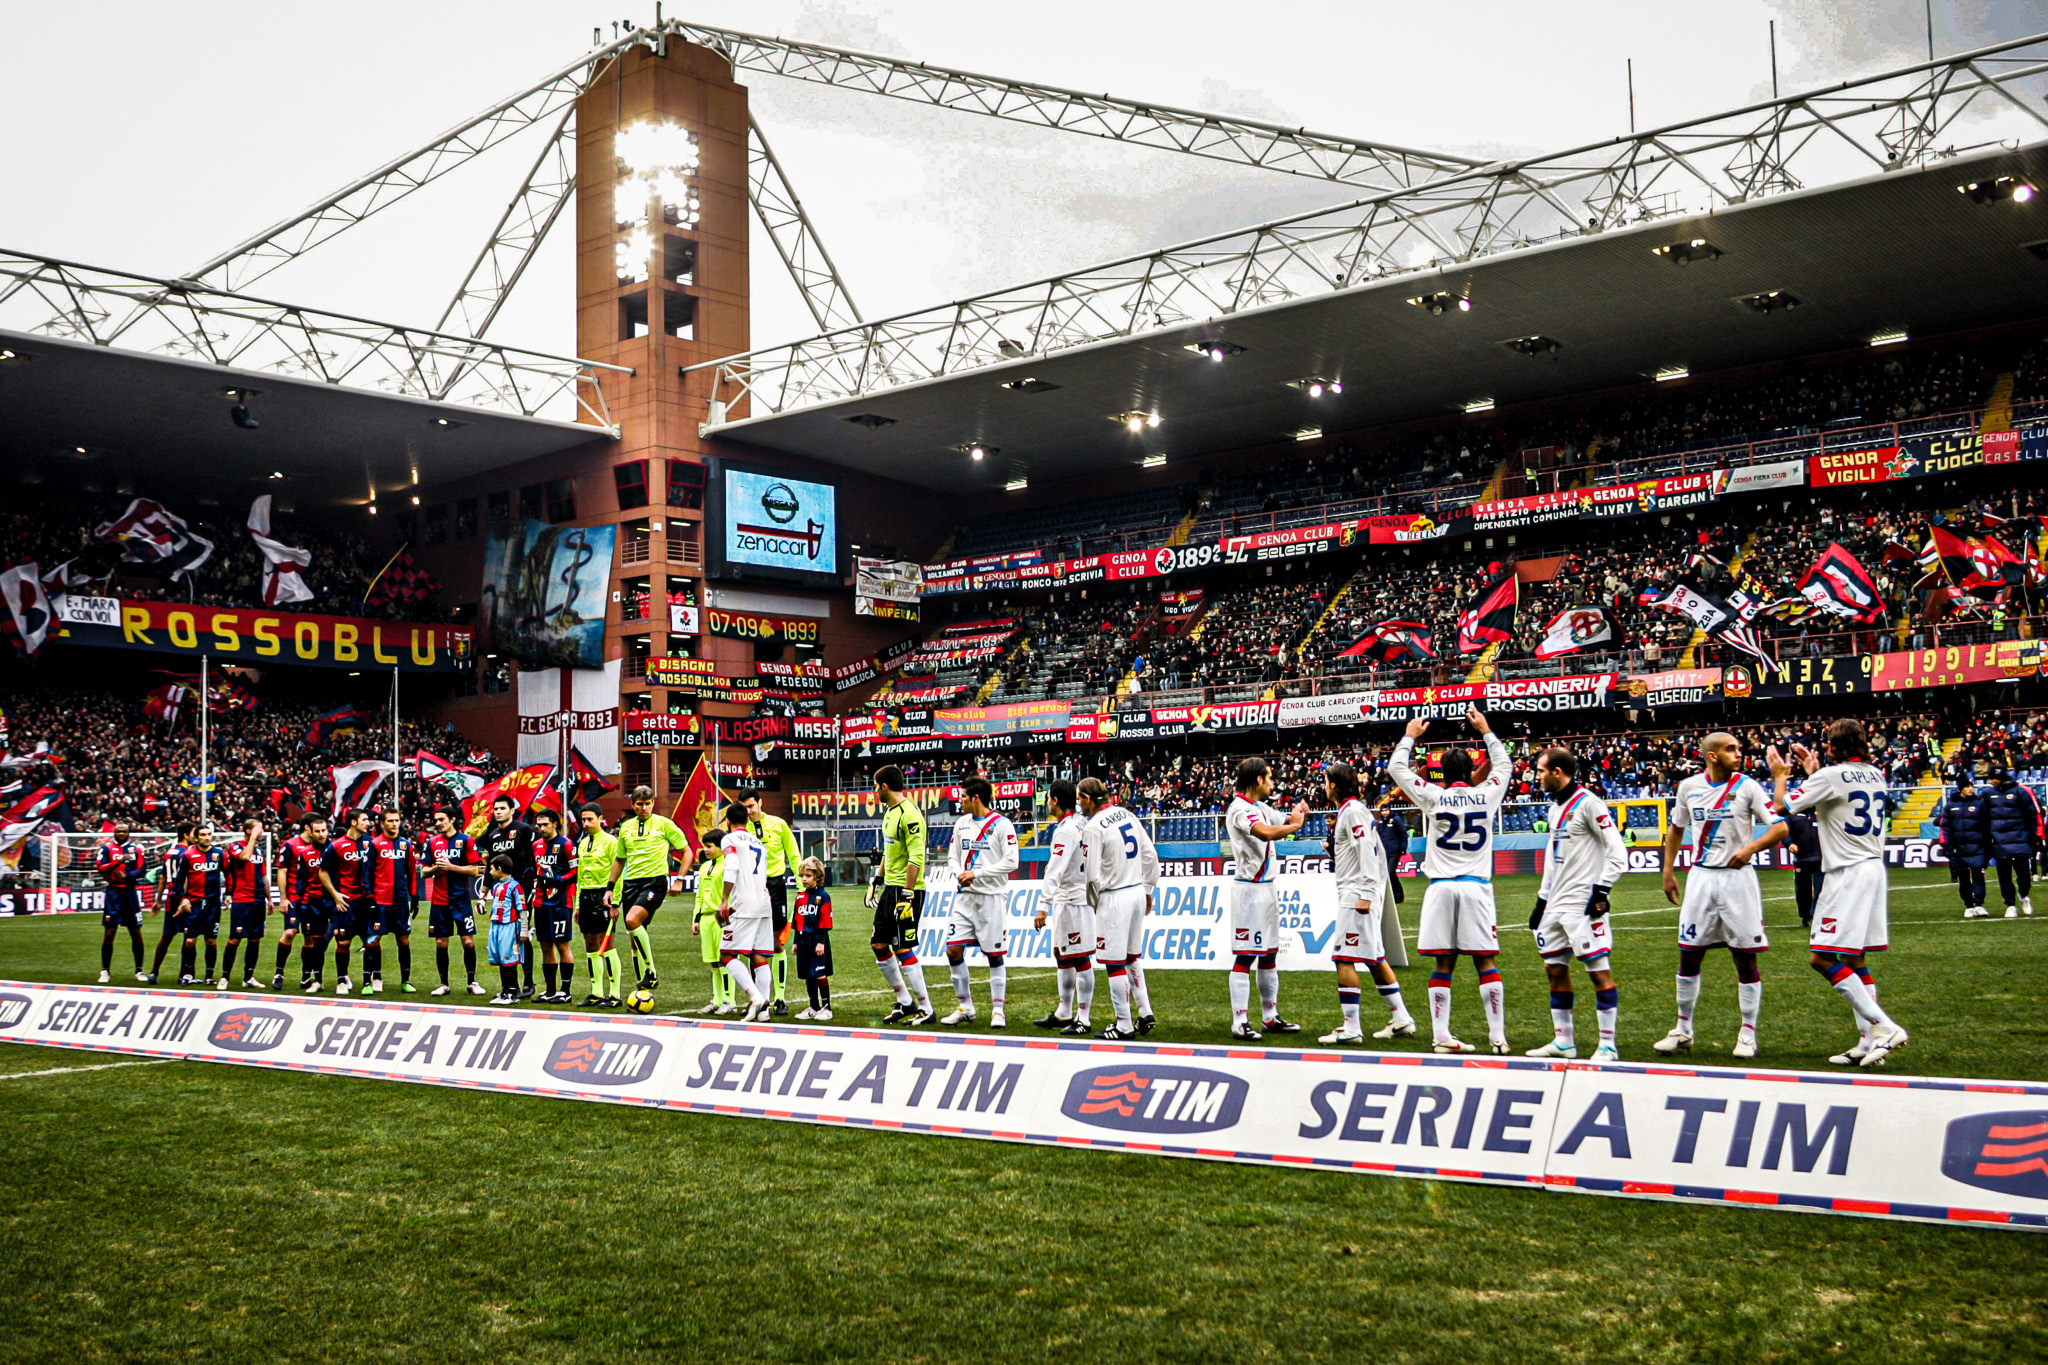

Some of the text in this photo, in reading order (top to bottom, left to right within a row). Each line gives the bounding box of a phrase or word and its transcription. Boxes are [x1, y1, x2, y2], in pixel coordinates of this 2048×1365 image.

[1983, 431, 2018, 443] GENOA
[1820, 451, 1879, 469] GENOA
[1985, 449, 2048, 463] CASELL
[1771, 471, 1787, 479] CLUB
[1826, 467, 1876, 484] VIGILI
[1593, 476, 1702, 501] GENOA CLUB
[1478, 499, 1525, 512] GENOA
[1595, 491, 1706, 516] LIVRY GARGAN
[1371, 508, 1472, 528] GENOA CLUB
[1476, 507, 1530, 521] FABRIZIO
[1474, 516, 1531, 530] DIPENDENTI
[1257, 526, 1334, 546] GENOA CLUB
[736, 533, 807, 556] zenacar
[1112, 552, 1147, 564] GENOA
[1020, 557, 1099, 576] GENOA CLUB
[1118, 565, 1145, 577] CLUB
[1022, 578, 1051, 590] RONCO
[1069, 568, 1104, 584] SCRIVIA
[81, 597, 116, 611] MARA
[70, 609, 111, 624] CON VOI
[874, 606, 918, 621] IMPERIA
[122, 606, 436, 667] ROSSOBLU
[782, 621, 817, 641] 1893
[659, 658, 715, 673] BISAGNO
[836, 659, 869, 678] GENOA
[888, 639, 914, 657] CLUB
[760, 662, 830, 678] GENOA CLUB
[736, 679, 759, 688] CLUB
[836, 669, 876, 691] GIANLUCA
[1486, 677, 1589, 697] BUCANIERI
[1796, 680, 1854, 696] CLUB
[697, 689, 713, 699] SAN
[1379, 687, 1472, 703] GENOA CLUB
[1646, 688, 1703, 706] EUSEBIO
[1281, 695, 1375, 710] GENOA CLUB CARLOFORTE
[1486, 693, 1592, 712] ROSSO BLU
[582, 710, 613, 729] 1893
[642, 714, 678, 729] sette
[845, 711, 927, 728] GENOA CLUB
[963, 709, 986, 719] club
[1069, 713, 1146, 726] GENOA CLUB
[1156, 702, 1278, 729] GENOA STUBAI
[1301, 716, 1316, 725] NON
[1318, 716, 1326, 724] SI
[1328, 713, 1361, 722] COMANDA
[628, 730, 695, 746] settembre
[845, 726, 931, 741] ANDREA VERRINA
[1070, 730, 1091, 740] LEIVI
[875, 739, 943, 754] SAMPIERDARENA
[961, 736, 1012, 750] PONTETTO
[1001, 783, 1029, 795] CLUB
[792, 793, 860, 817] PIAZZA
[1435, 811, 1488, 852] 25
[492, 840, 515, 852] GAUDI
[1118, 822, 1138, 860] 5
[380, 848, 406, 859] GAUDI
[434, 848, 461, 859] GAUDI
[535, 854, 558, 865] GAUDI
[749, 845, 762, 875] 7
[193, 862, 219, 872] GAUDI
[553, 920, 567, 934] 77
[1681, 923, 1697, 939] 14
[1253, 931, 1262, 945] 6
[38, 999, 200, 1042] SERIE A TIM
[243, 1017, 286, 1045] TIM
[303, 1016, 527, 1072] SERIE A TIM
[594, 1042, 652, 1077] TIM
[686, 1042, 1025, 1114] SERIE A TIM
[1140, 1079, 1230, 1124] TIM
[1298, 1079, 1859, 1176] SERIE A TIM
